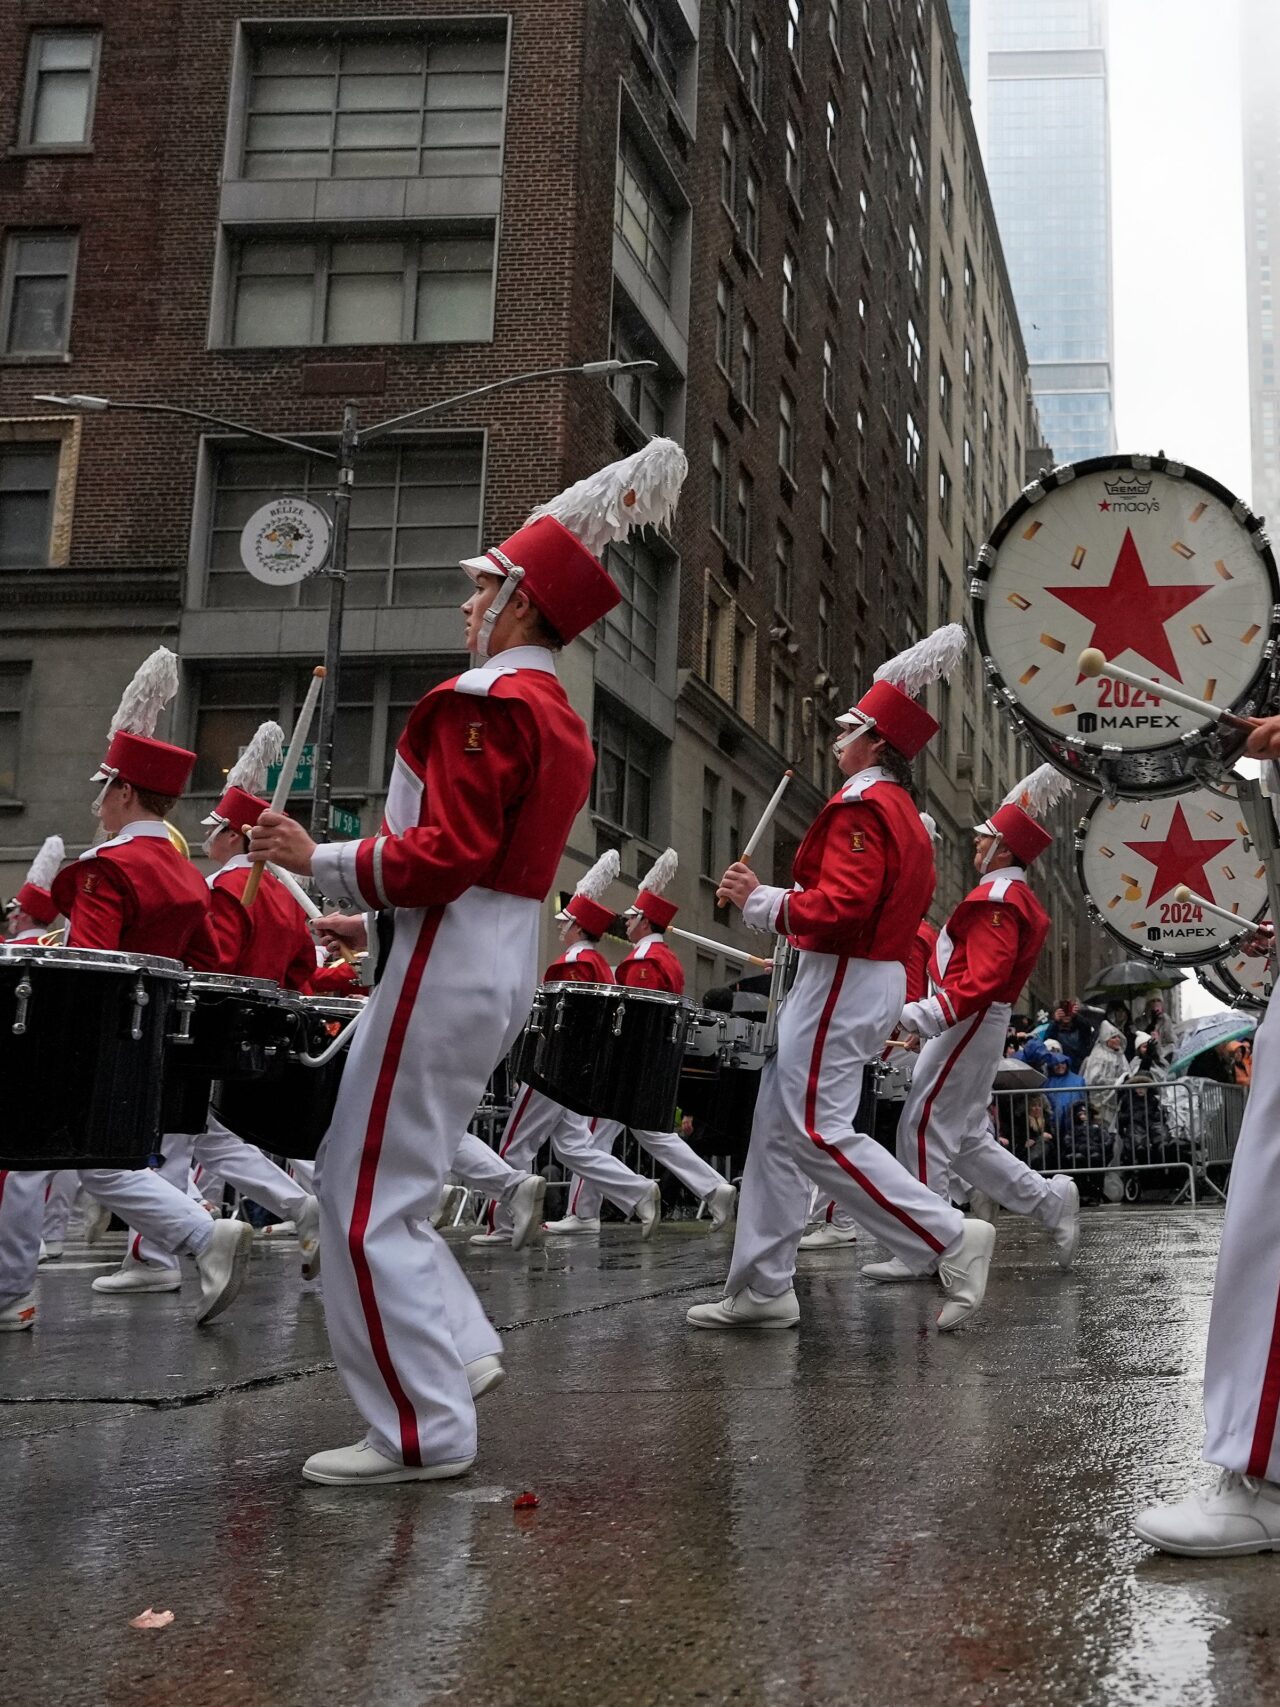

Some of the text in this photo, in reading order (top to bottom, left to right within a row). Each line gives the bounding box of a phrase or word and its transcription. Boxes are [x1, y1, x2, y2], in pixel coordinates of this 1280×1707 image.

[270, 506, 304, 517] BELIZE
[1097, 678, 1161, 707] 2024
[1101, 715, 1179, 729] MAPEX
[334, 810, 342, 828] W
[343, 814, 353, 833] 58
[1160, 903, 1203, 924] 2024
[1162, 927, 1216, 938] MAPEX
